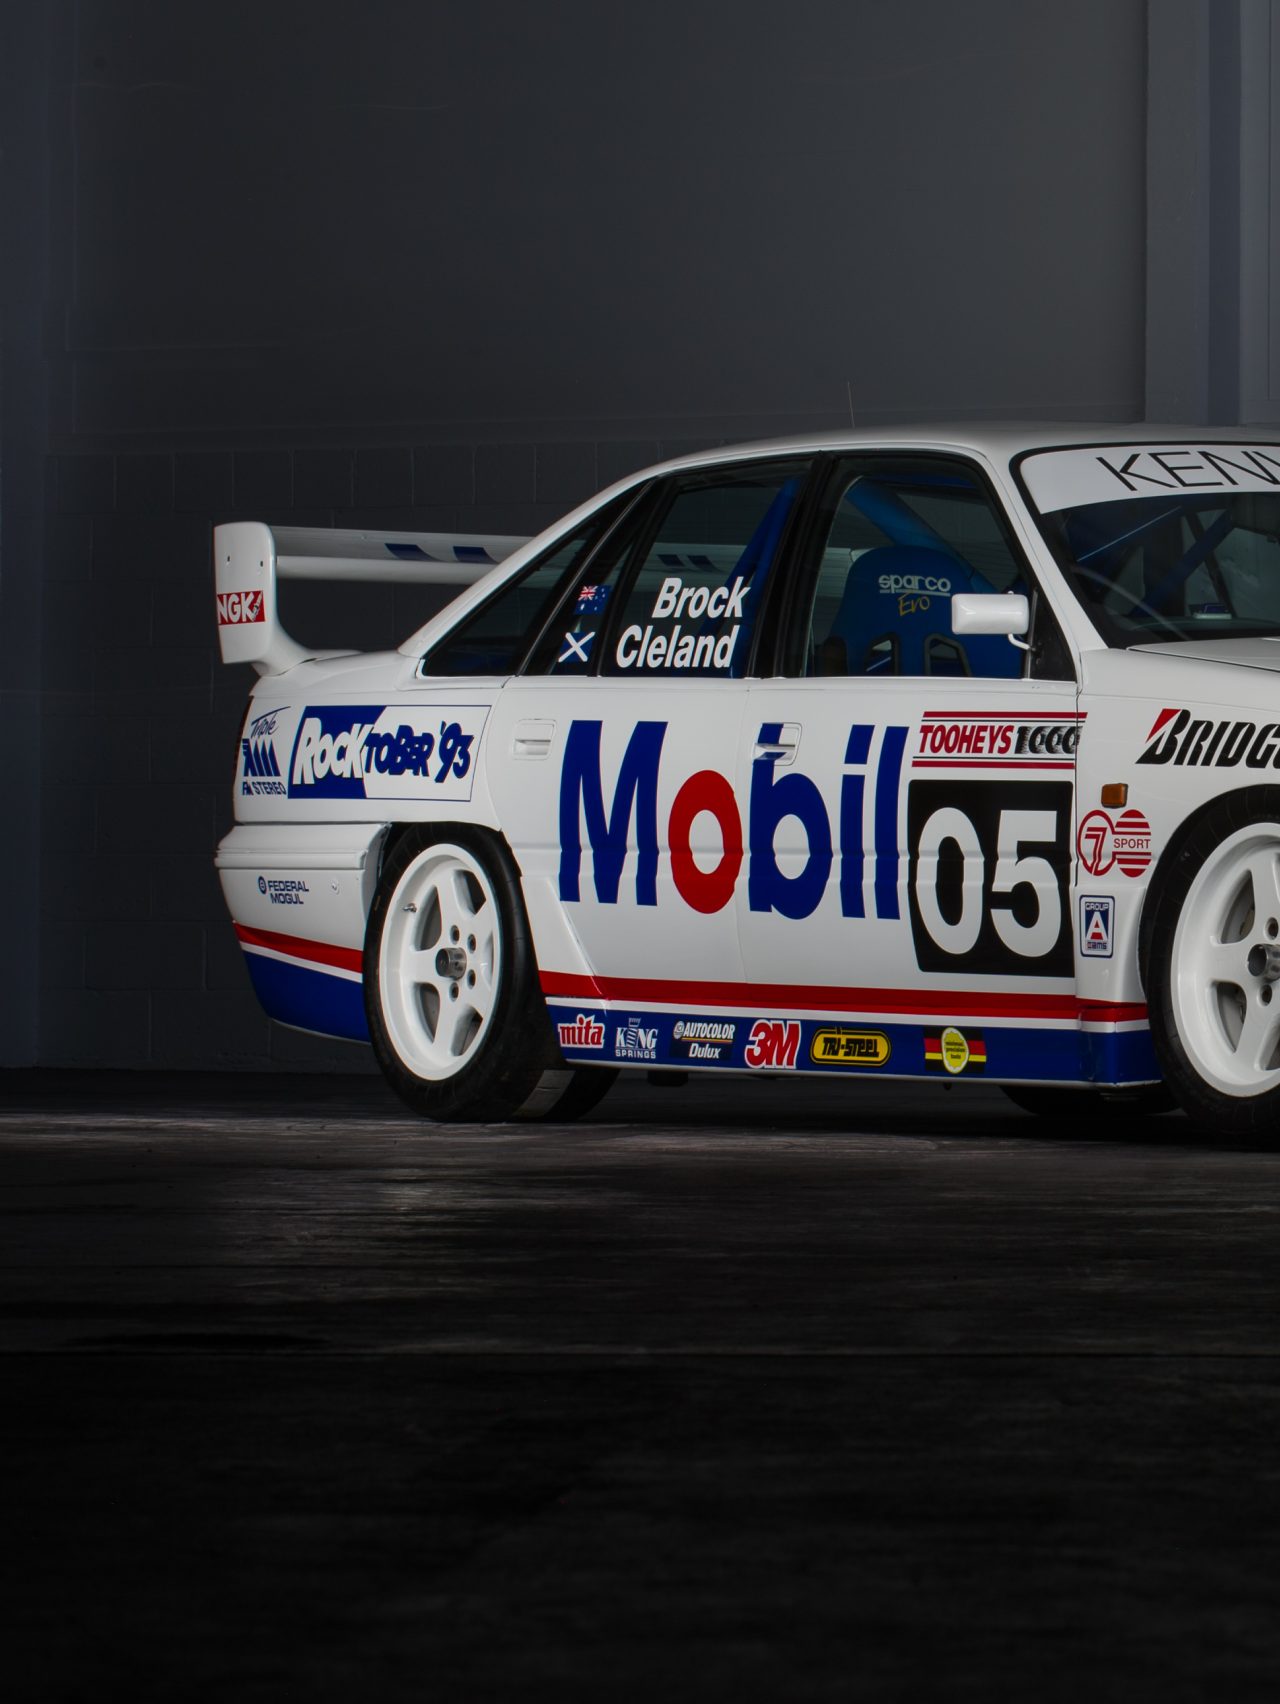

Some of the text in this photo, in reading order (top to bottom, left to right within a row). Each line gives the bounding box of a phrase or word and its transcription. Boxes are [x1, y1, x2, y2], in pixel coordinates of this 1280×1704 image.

[651, 576, 751, 620] Brock
[878, 574, 952, 593] sparco
[217, 592, 257, 624] NGK
[615, 624, 741, 669] Cleland
[919, 724, 1083, 755] TOOHEYS 1000
[252, 781, 287, 796] STEREO
[559, 719, 910, 920] Mobil
[1113, 838, 1152, 849] SPORT
[267, 880, 310, 892] FEDERAL
[915, 806, 1062, 958] 05
[270, 893, 305, 905] MOGUL
[1085, 902, 1110, 911] GROUP
[1085, 911, 1109, 940] A
[558, 1015, 605, 1047] mita
[615, 1019, 659, 1050] KING
[683, 1021, 736, 1041] AUTOCOLOR
[745, 1020, 801, 1069] 3M
[615, 1049, 658, 1060] SPRINGS
[688, 1042, 721, 1060] Dulux
